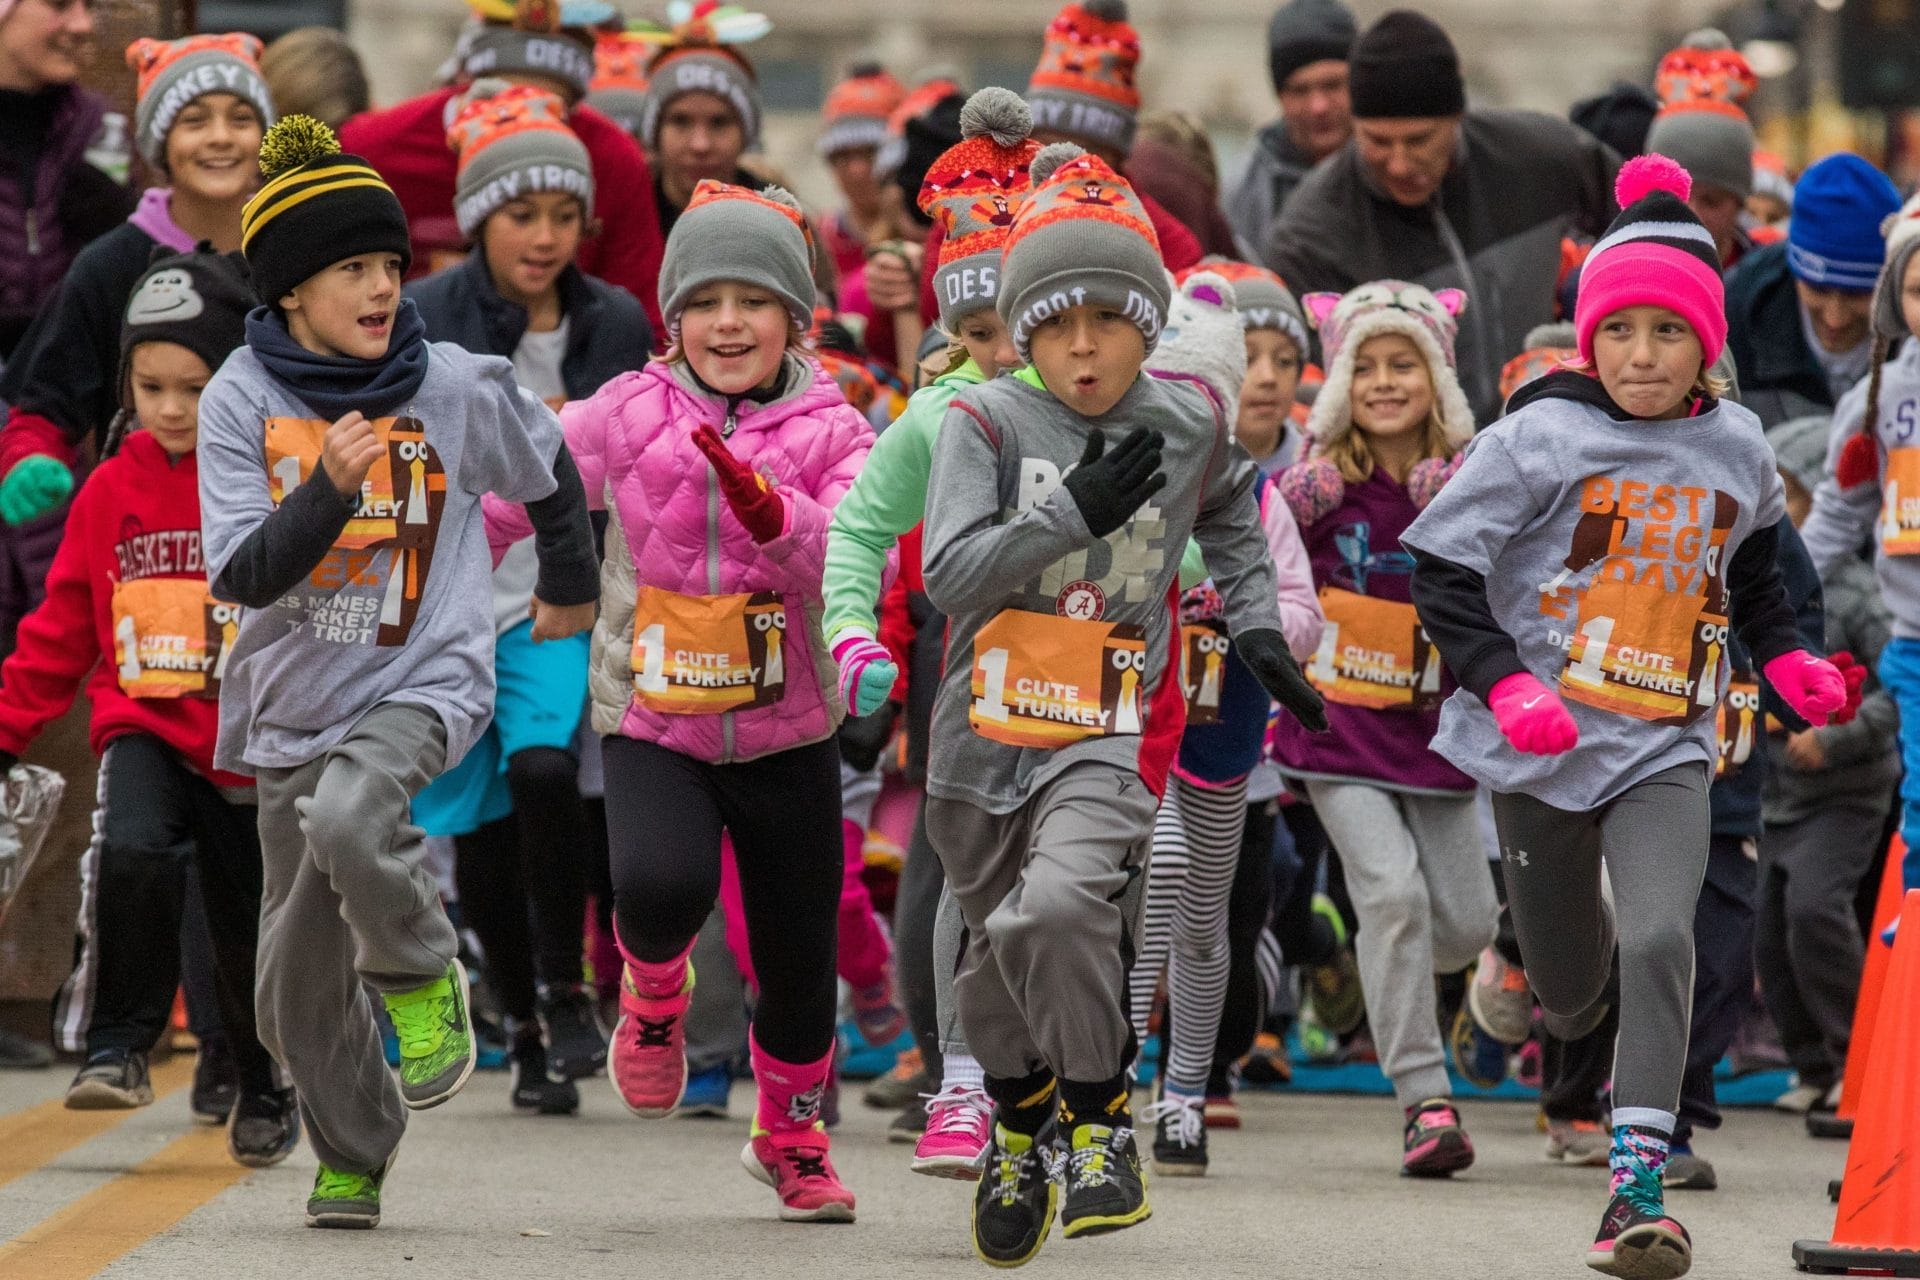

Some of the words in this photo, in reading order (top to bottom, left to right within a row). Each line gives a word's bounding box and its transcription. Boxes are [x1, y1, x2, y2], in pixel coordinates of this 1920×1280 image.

[945, 266, 996, 305] DES
[1580, 475, 1707, 524] BEST
[1607, 519, 1703, 564] LEG
[1068, 595, 1090, 616] A
[116, 614, 141, 679] 1
[140, 634, 188, 653] CUTE
[634, 623, 668, 694] 1
[674, 649, 730, 669] CUTE
[1307, 620, 1340, 684] 1
[1343, 645, 1397, 670] CUTE
[1567, 615, 1616, 688] 1
[1616, 646, 1675, 673] CUTE
[673, 666, 762, 688] TURKEY
[975, 646, 1010, 724] 1
[1015, 677, 1080, 703] CUTE
[1341, 661, 1421, 687] TURKEY
[1613, 664, 1696, 698] TURKEY
[1014, 696, 1112, 727] TURKEY
